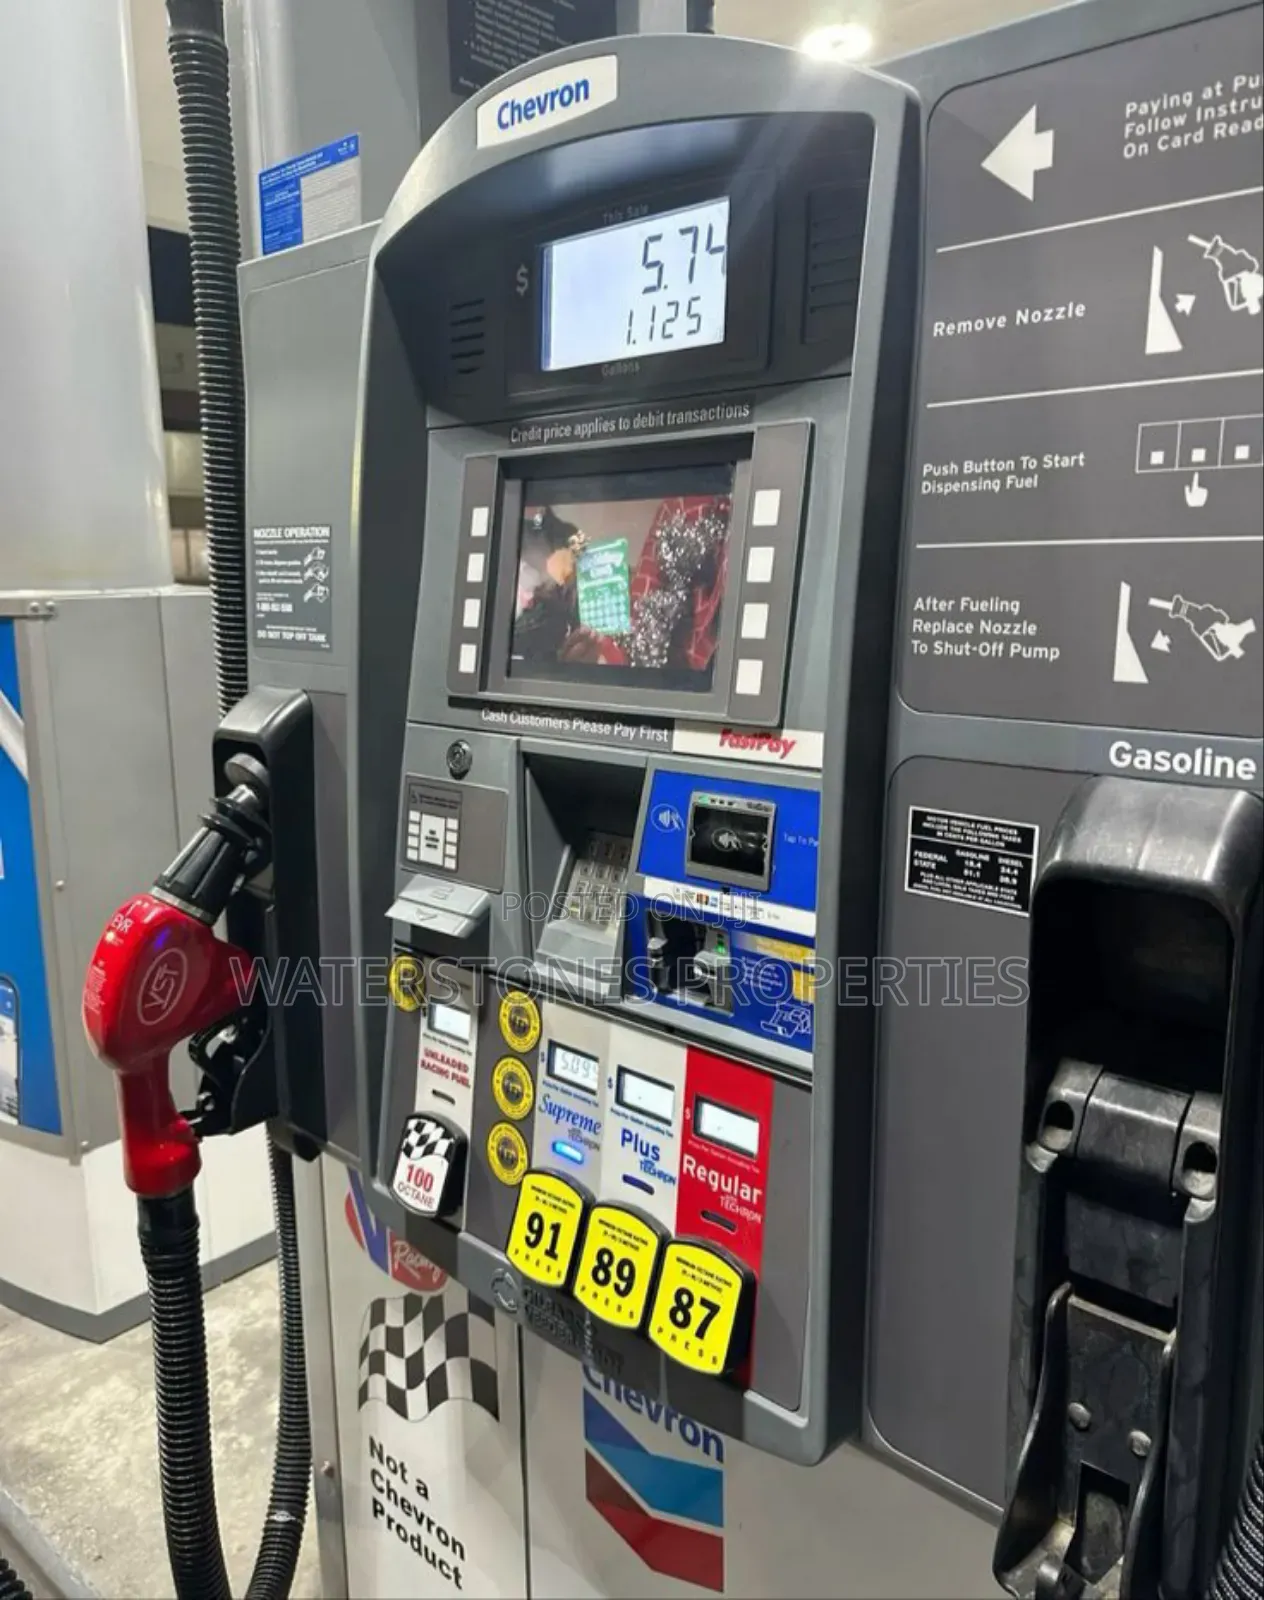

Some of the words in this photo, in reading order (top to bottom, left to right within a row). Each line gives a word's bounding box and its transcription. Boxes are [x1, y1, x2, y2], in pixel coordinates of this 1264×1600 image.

[497, 78, 590, 130] Chevron
[1124, 90, 1193, 119] Paying
[1201, 80, 1223, 100] at
[1232, 73, 1264, 93] Pu
[1123, 113, 1187, 139] Follow
[1196, 94, 1263, 123] Instru
[1122, 142, 1149, 159] On
[1156, 126, 1204, 152] Card
[1213, 112, 1264, 140] Read
[603, 209, 624, 224] This
[626, 204, 649, 219] Sale
[641, 222, 727, 294] 5.74
[515, 264, 529, 295] $
[625, 296, 701, 345] 1.125
[932, 314, 1007, 337] Remove
[1015, 301, 1086, 326] Nozzle
[601, 360, 641, 377] Gallons
[510, 426, 542, 444] Credit
[543, 422, 571, 443] price
[574, 416, 616, 439] applies
[618, 416, 630, 432] to
[632, 410, 664, 430] debit
[667, 402, 750, 425] transactions
[922, 461, 959, 478] Push
[963, 457, 1015, 475] Button
[1020, 455, 1038, 471] To
[1043, 452, 1086, 469] Start
[921, 476, 1001, 496] Dispensing
[1005, 474, 1039, 490] Fuel
[253, 527, 282, 538] NOZZLE
[284, 526, 330, 539] OPERATION
[913, 595, 955, 612] After
[960, 596, 1021, 616] Fueling
[912, 618, 975, 636] Replace
[979, 619, 1038, 636] Nozzle
[911, 639, 928, 654] To
[933, 640, 1004, 657] Shut-Off
[1009, 642, 1061, 662] Pump
[481, 708, 508, 724] Cash
[509, 711, 570, 731] Customers
[572, 717, 611, 737] Please
[613, 722, 636, 741] Pay
[639, 725, 669, 743] First
[718, 727, 797, 759] FastPay
[1108, 739, 1257, 781] Gasoline
[808, 836, 820, 848] Pa
[913, 850, 948, 863] FEDERAL
[420, 1059, 450, 1080] RACING
[451, 1072, 471, 1089] FUEL
[423, 1047, 470, 1074] UNLEADED
[537, 1092, 603, 1136] Supreme
[620, 1126, 661, 1162] Plus
[397, 1182, 436, 1210] OCTANE
[406, 1164, 434, 1193] 100
[682, 1153, 763, 1205] Regular
[719, 1195, 763, 1224] TECHRON
[524, 1211, 562, 1262] 91
[591, 1246, 636, 1298] 89
[668, 1286, 721, 1341] 87
[368, 1434, 409, 1486] Not
[415, 1477, 430, 1502] a
[370, 1467, 466, 1562] Chevron
[372, 1496, 463, 1591] Product
